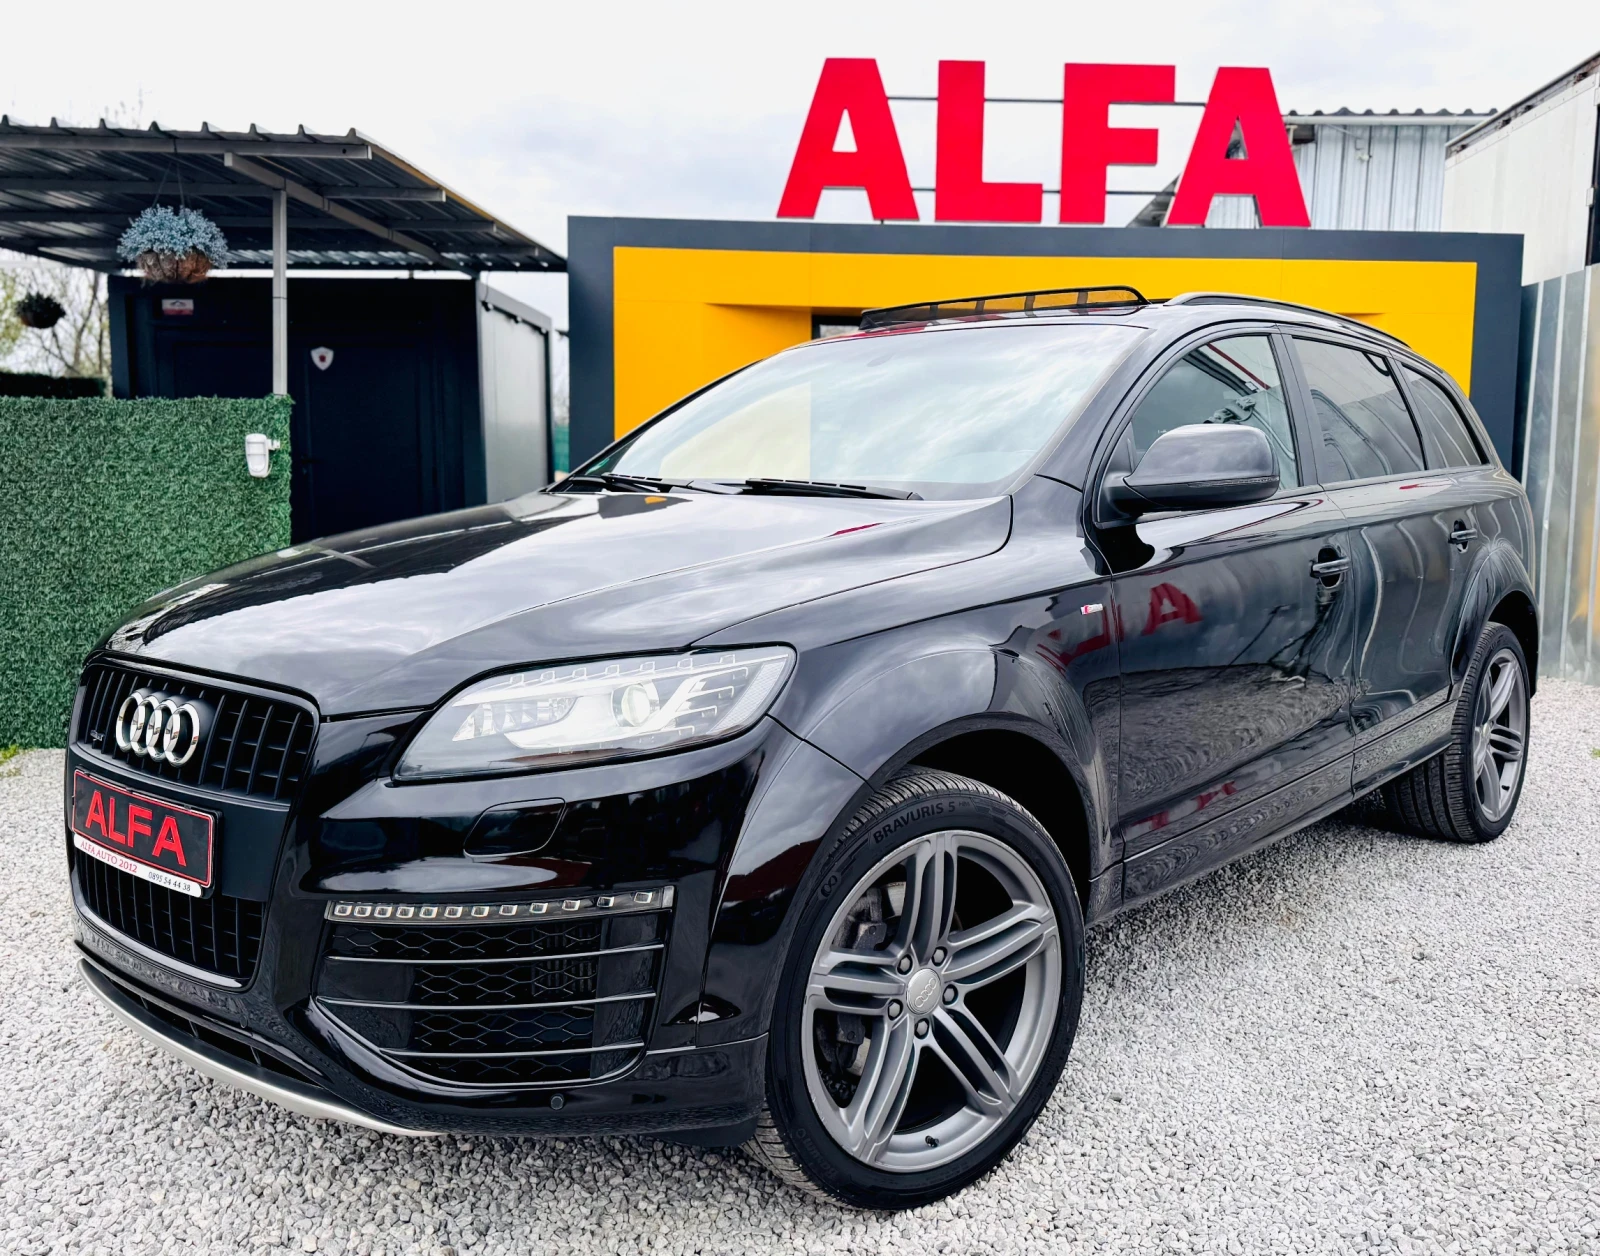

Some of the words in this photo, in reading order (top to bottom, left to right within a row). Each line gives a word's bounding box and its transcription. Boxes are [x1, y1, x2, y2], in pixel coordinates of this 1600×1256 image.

[776, 57, 1311, 228] ALFA
[85, 790, 187, 867] ALFA
[872, 802, 944, 844] BRAVURIS
[948, 801, 956, 813] 5
[80, 840, 96, 856] ALFA
[97, 849, 118, 866] AUTO
[119, 860, 138, 874] 2012
[148, 871, 163, 884] 0895
[164, 877, 172, 887] 54
[172, 880, 182, 890] 44
[182, 883, 191, 892] 38
